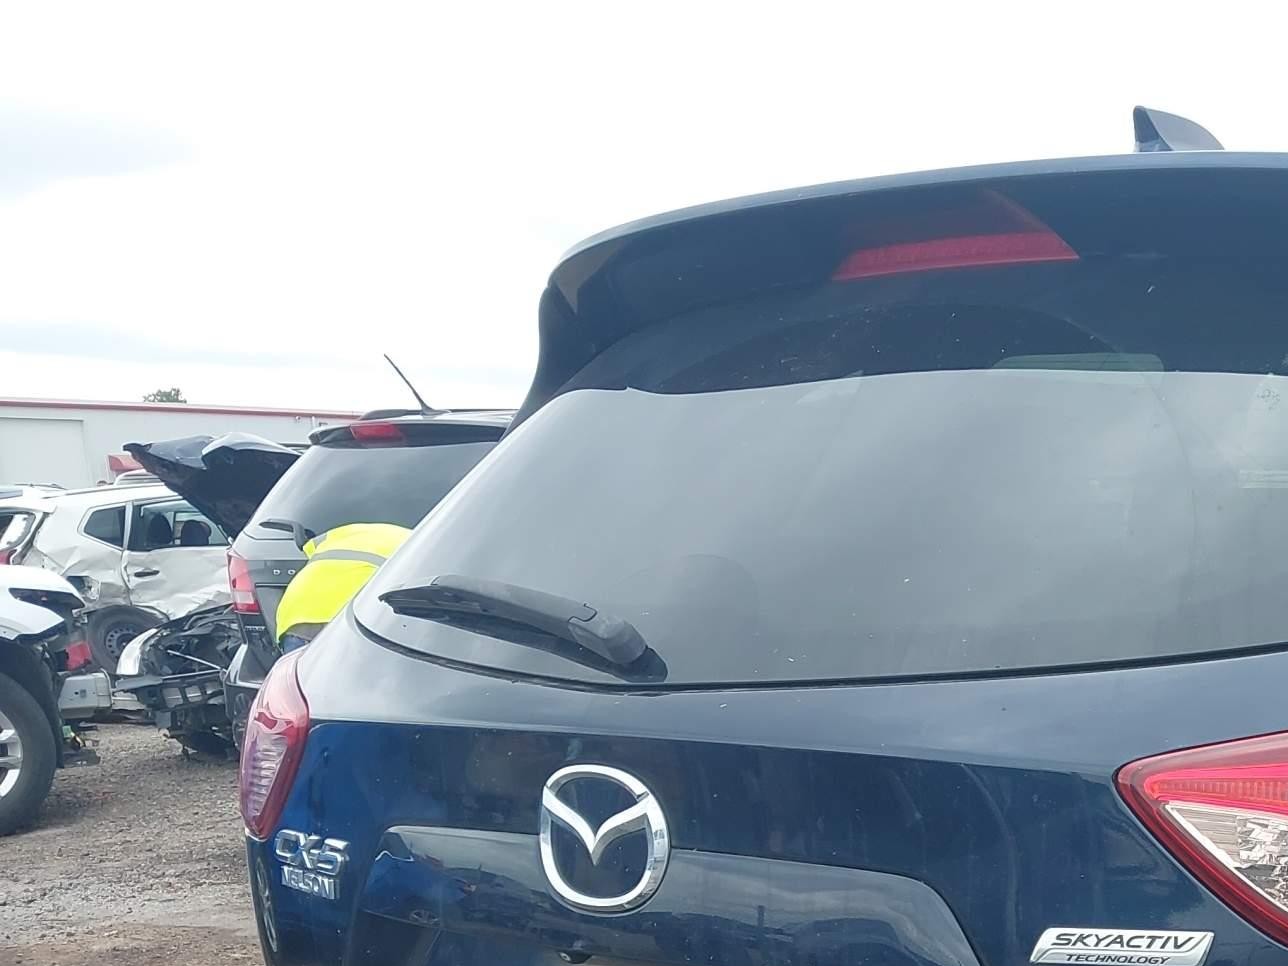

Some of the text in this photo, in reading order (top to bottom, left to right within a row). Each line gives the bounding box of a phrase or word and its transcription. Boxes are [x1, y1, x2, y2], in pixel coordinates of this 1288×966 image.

[275, 829, 349, 875] CX-5
[1051, 932, 1196, 950] SKYACTIV
[1066, 953, 1171, 965] TECHNOLOGY
